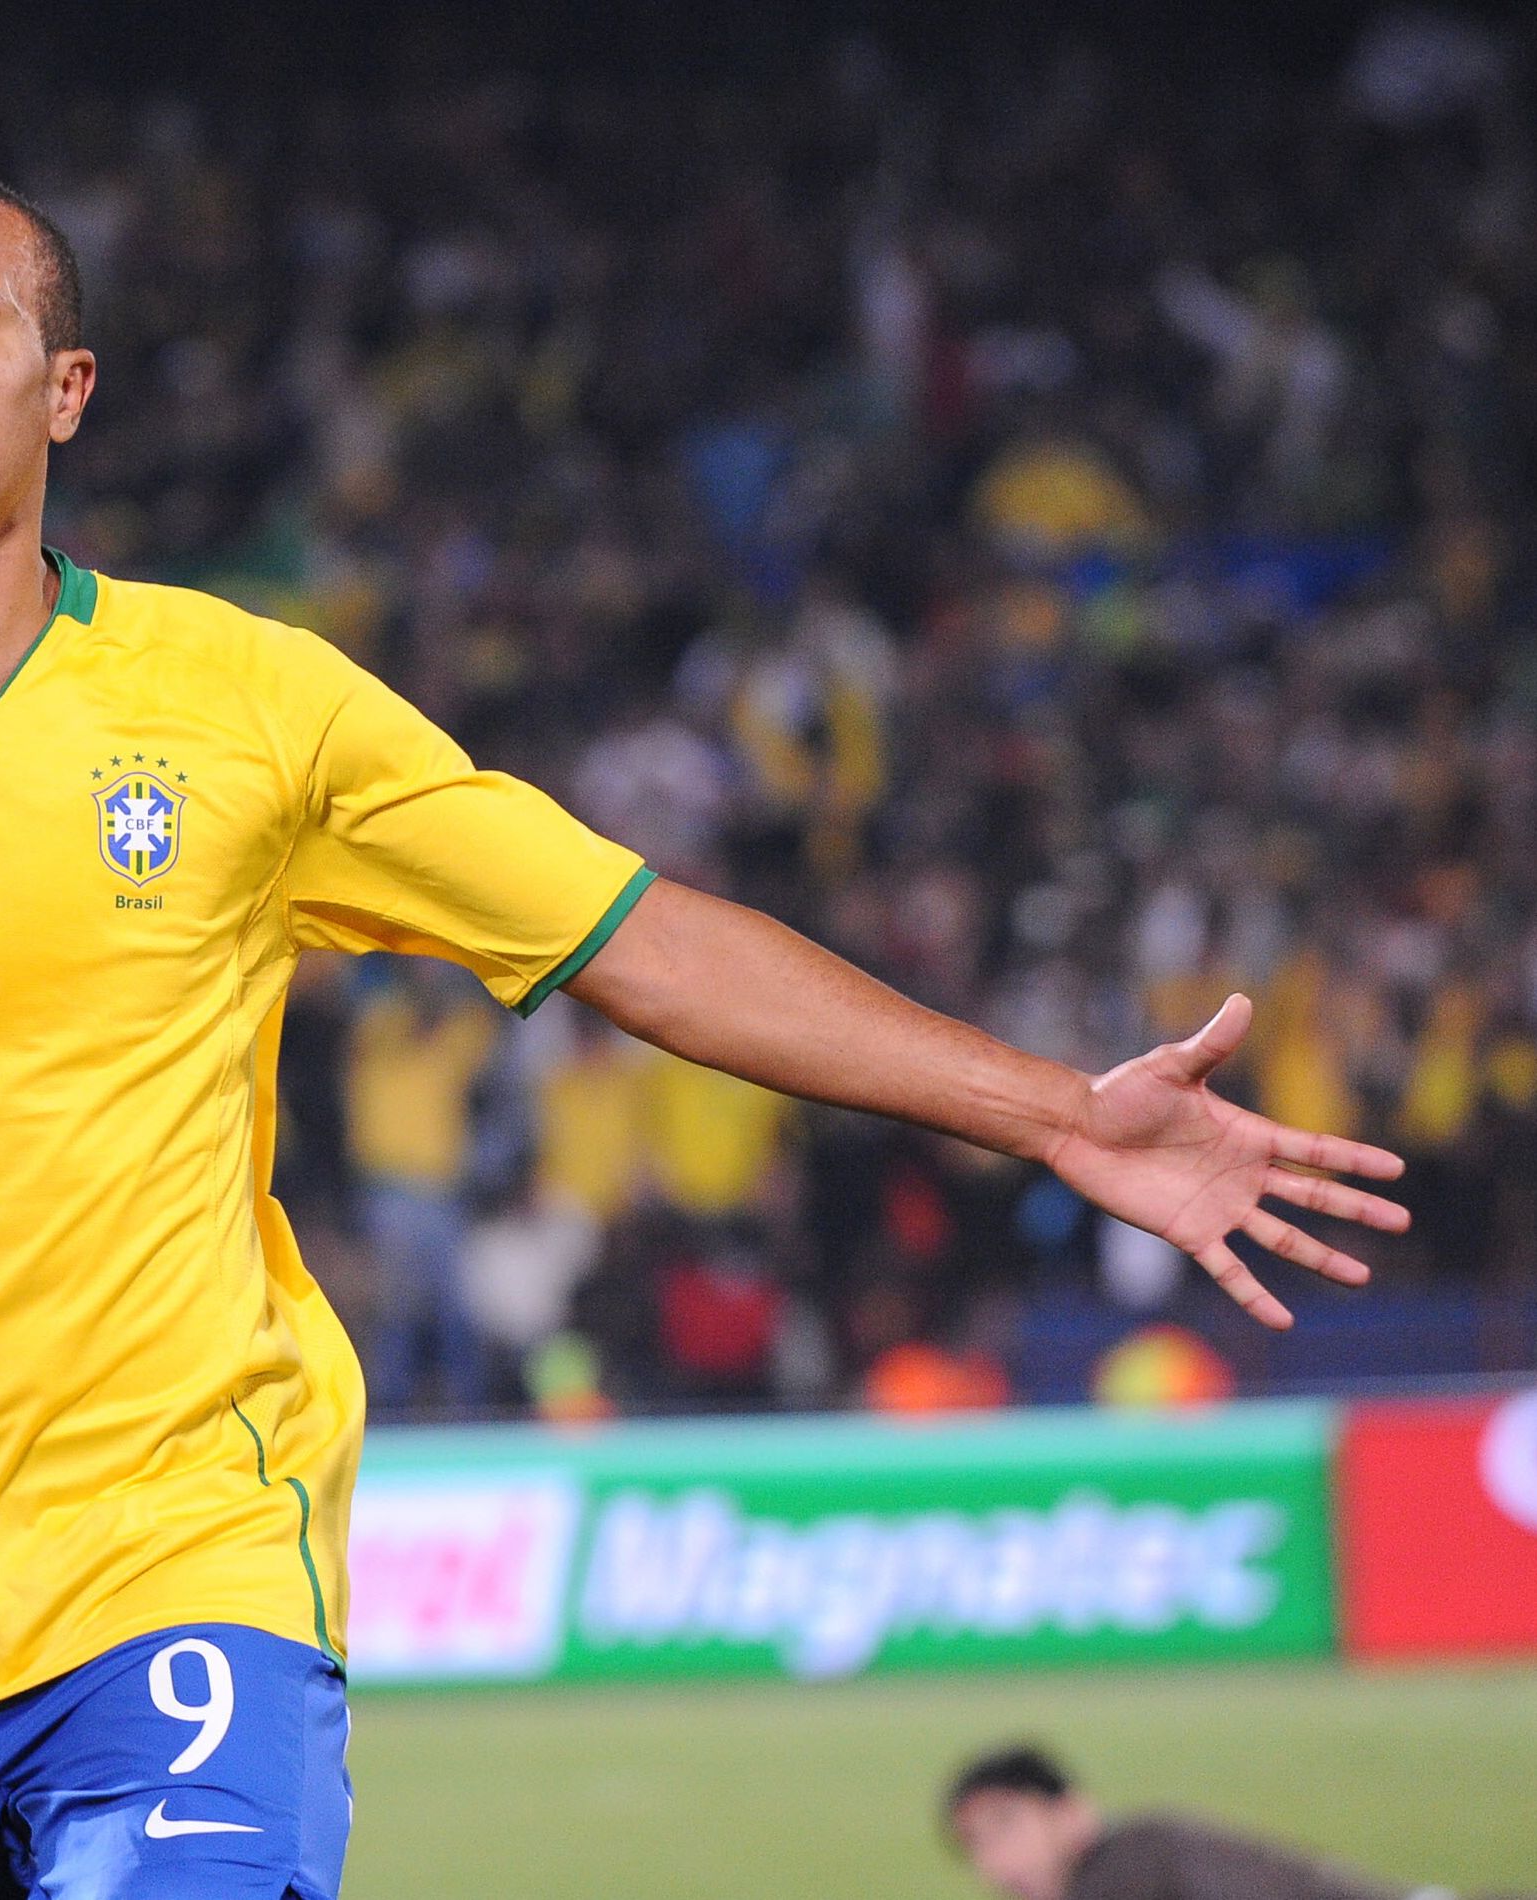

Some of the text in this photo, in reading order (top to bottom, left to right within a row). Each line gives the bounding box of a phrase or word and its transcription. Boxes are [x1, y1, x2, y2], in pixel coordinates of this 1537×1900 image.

[125, 818, 155, 831] CBF
[115, 895, 163, 910] Brasil
[148, 1637, 235, 1776] 9
